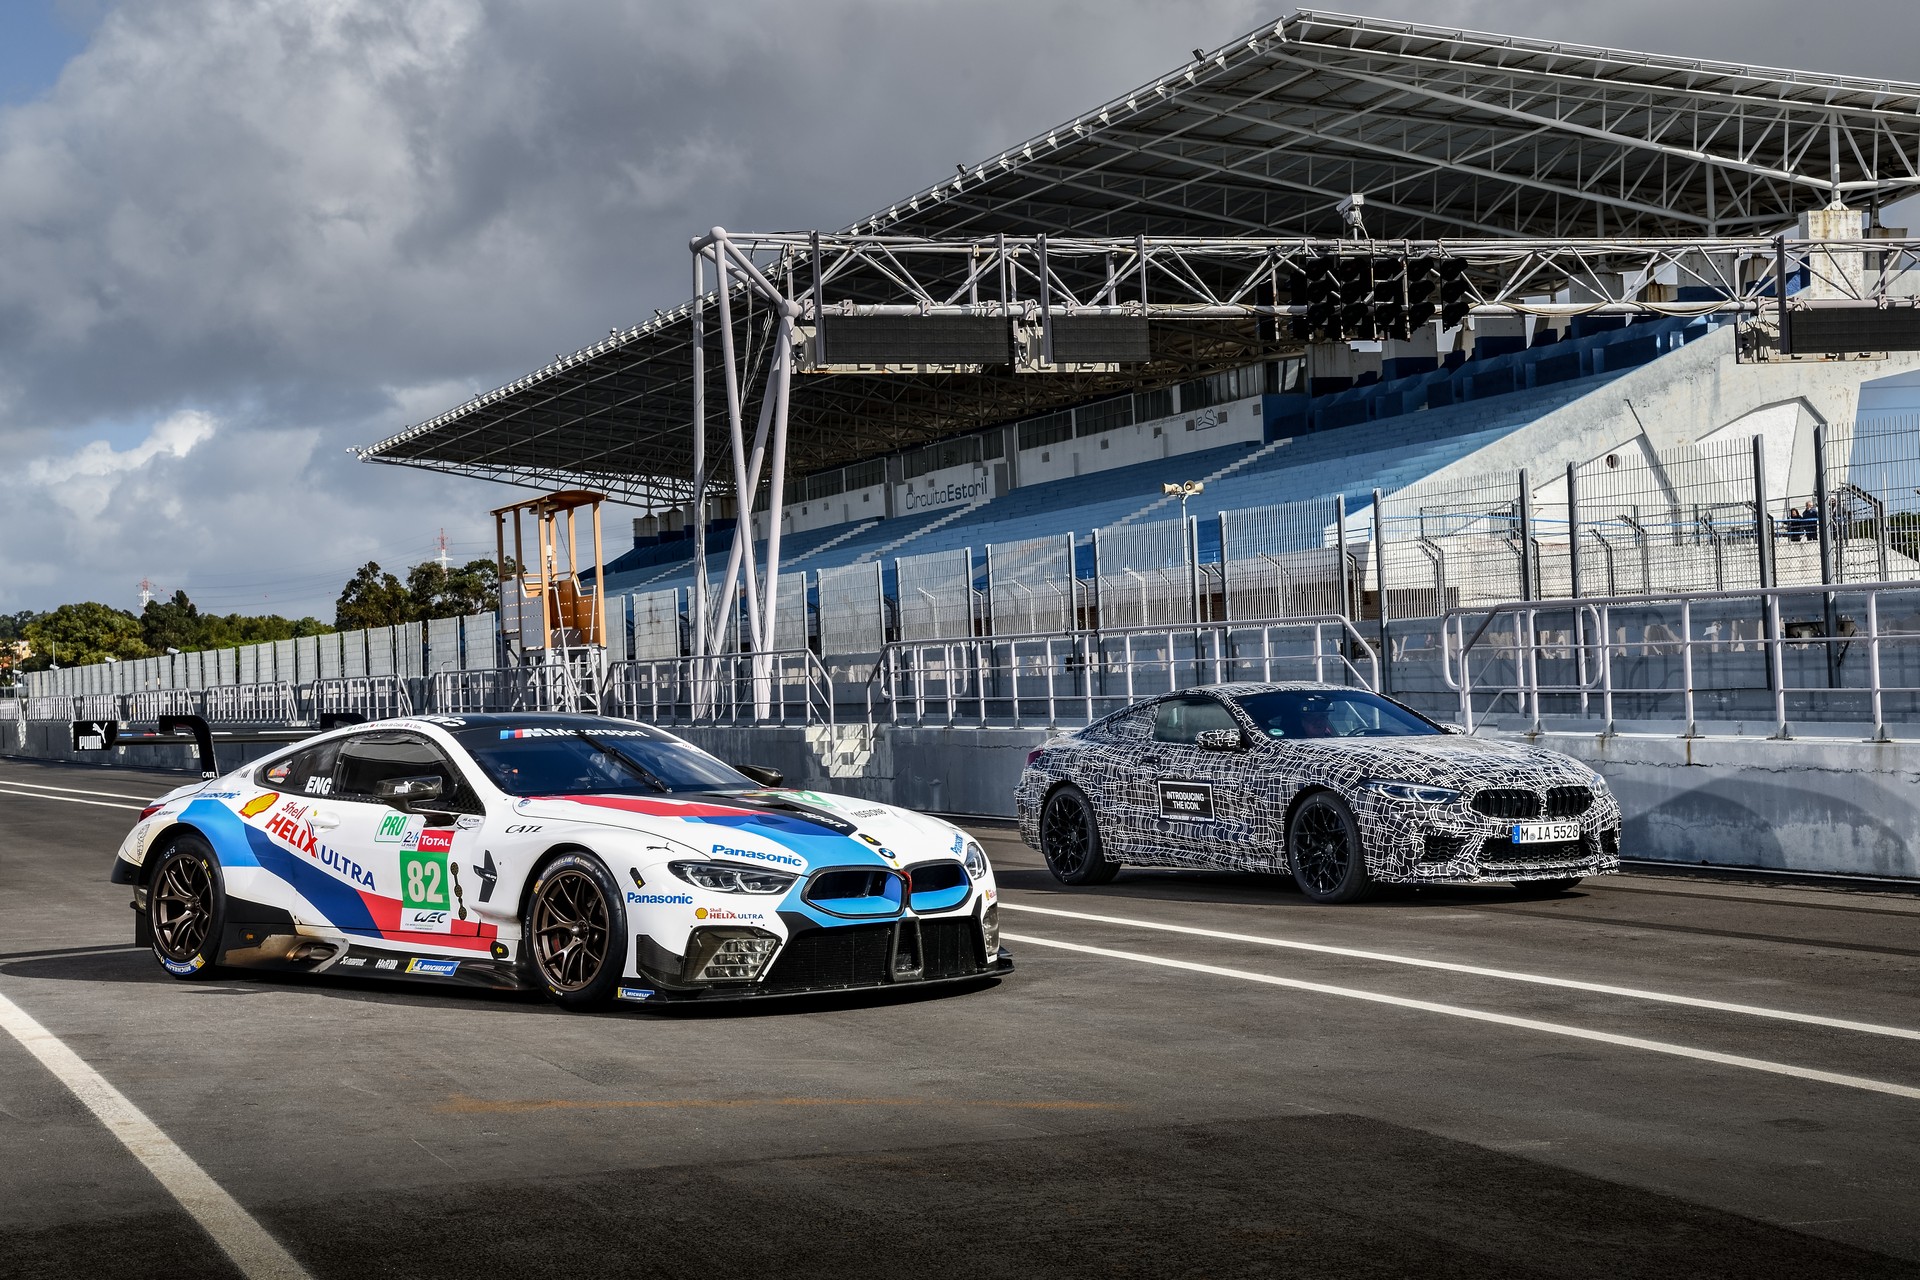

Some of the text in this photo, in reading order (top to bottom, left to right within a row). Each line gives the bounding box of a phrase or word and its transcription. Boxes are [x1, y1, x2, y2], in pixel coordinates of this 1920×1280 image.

[547, 728, 650, 738] Moorsport
[79, 736, 102, 749] PUMA
[304, 775, 333, 795] ENG
[1166, 791, 1205, 802] INTRODUCING
[281, 801, 308, 820] Shell
[1172, 800, 1201, 811] THE ICON.
[380, 815, 407, 837] PRO
[505, 825, 543, 834] CATL
[1520, 827, 1529, 841] M
[1553, 824, 1579, 839] 5528
[265, 813, 376, 891] HELIX ULTRA
[712, 844, 803, 867] Panasonic
[406, 860, 444, 903] 82
[626, 892, 693, 905] Panasonic
[413, 911, 448, 924] WEC
[709, 910, 737, 919] HELIX
[421, 964, 454, 972] MICHELIN
